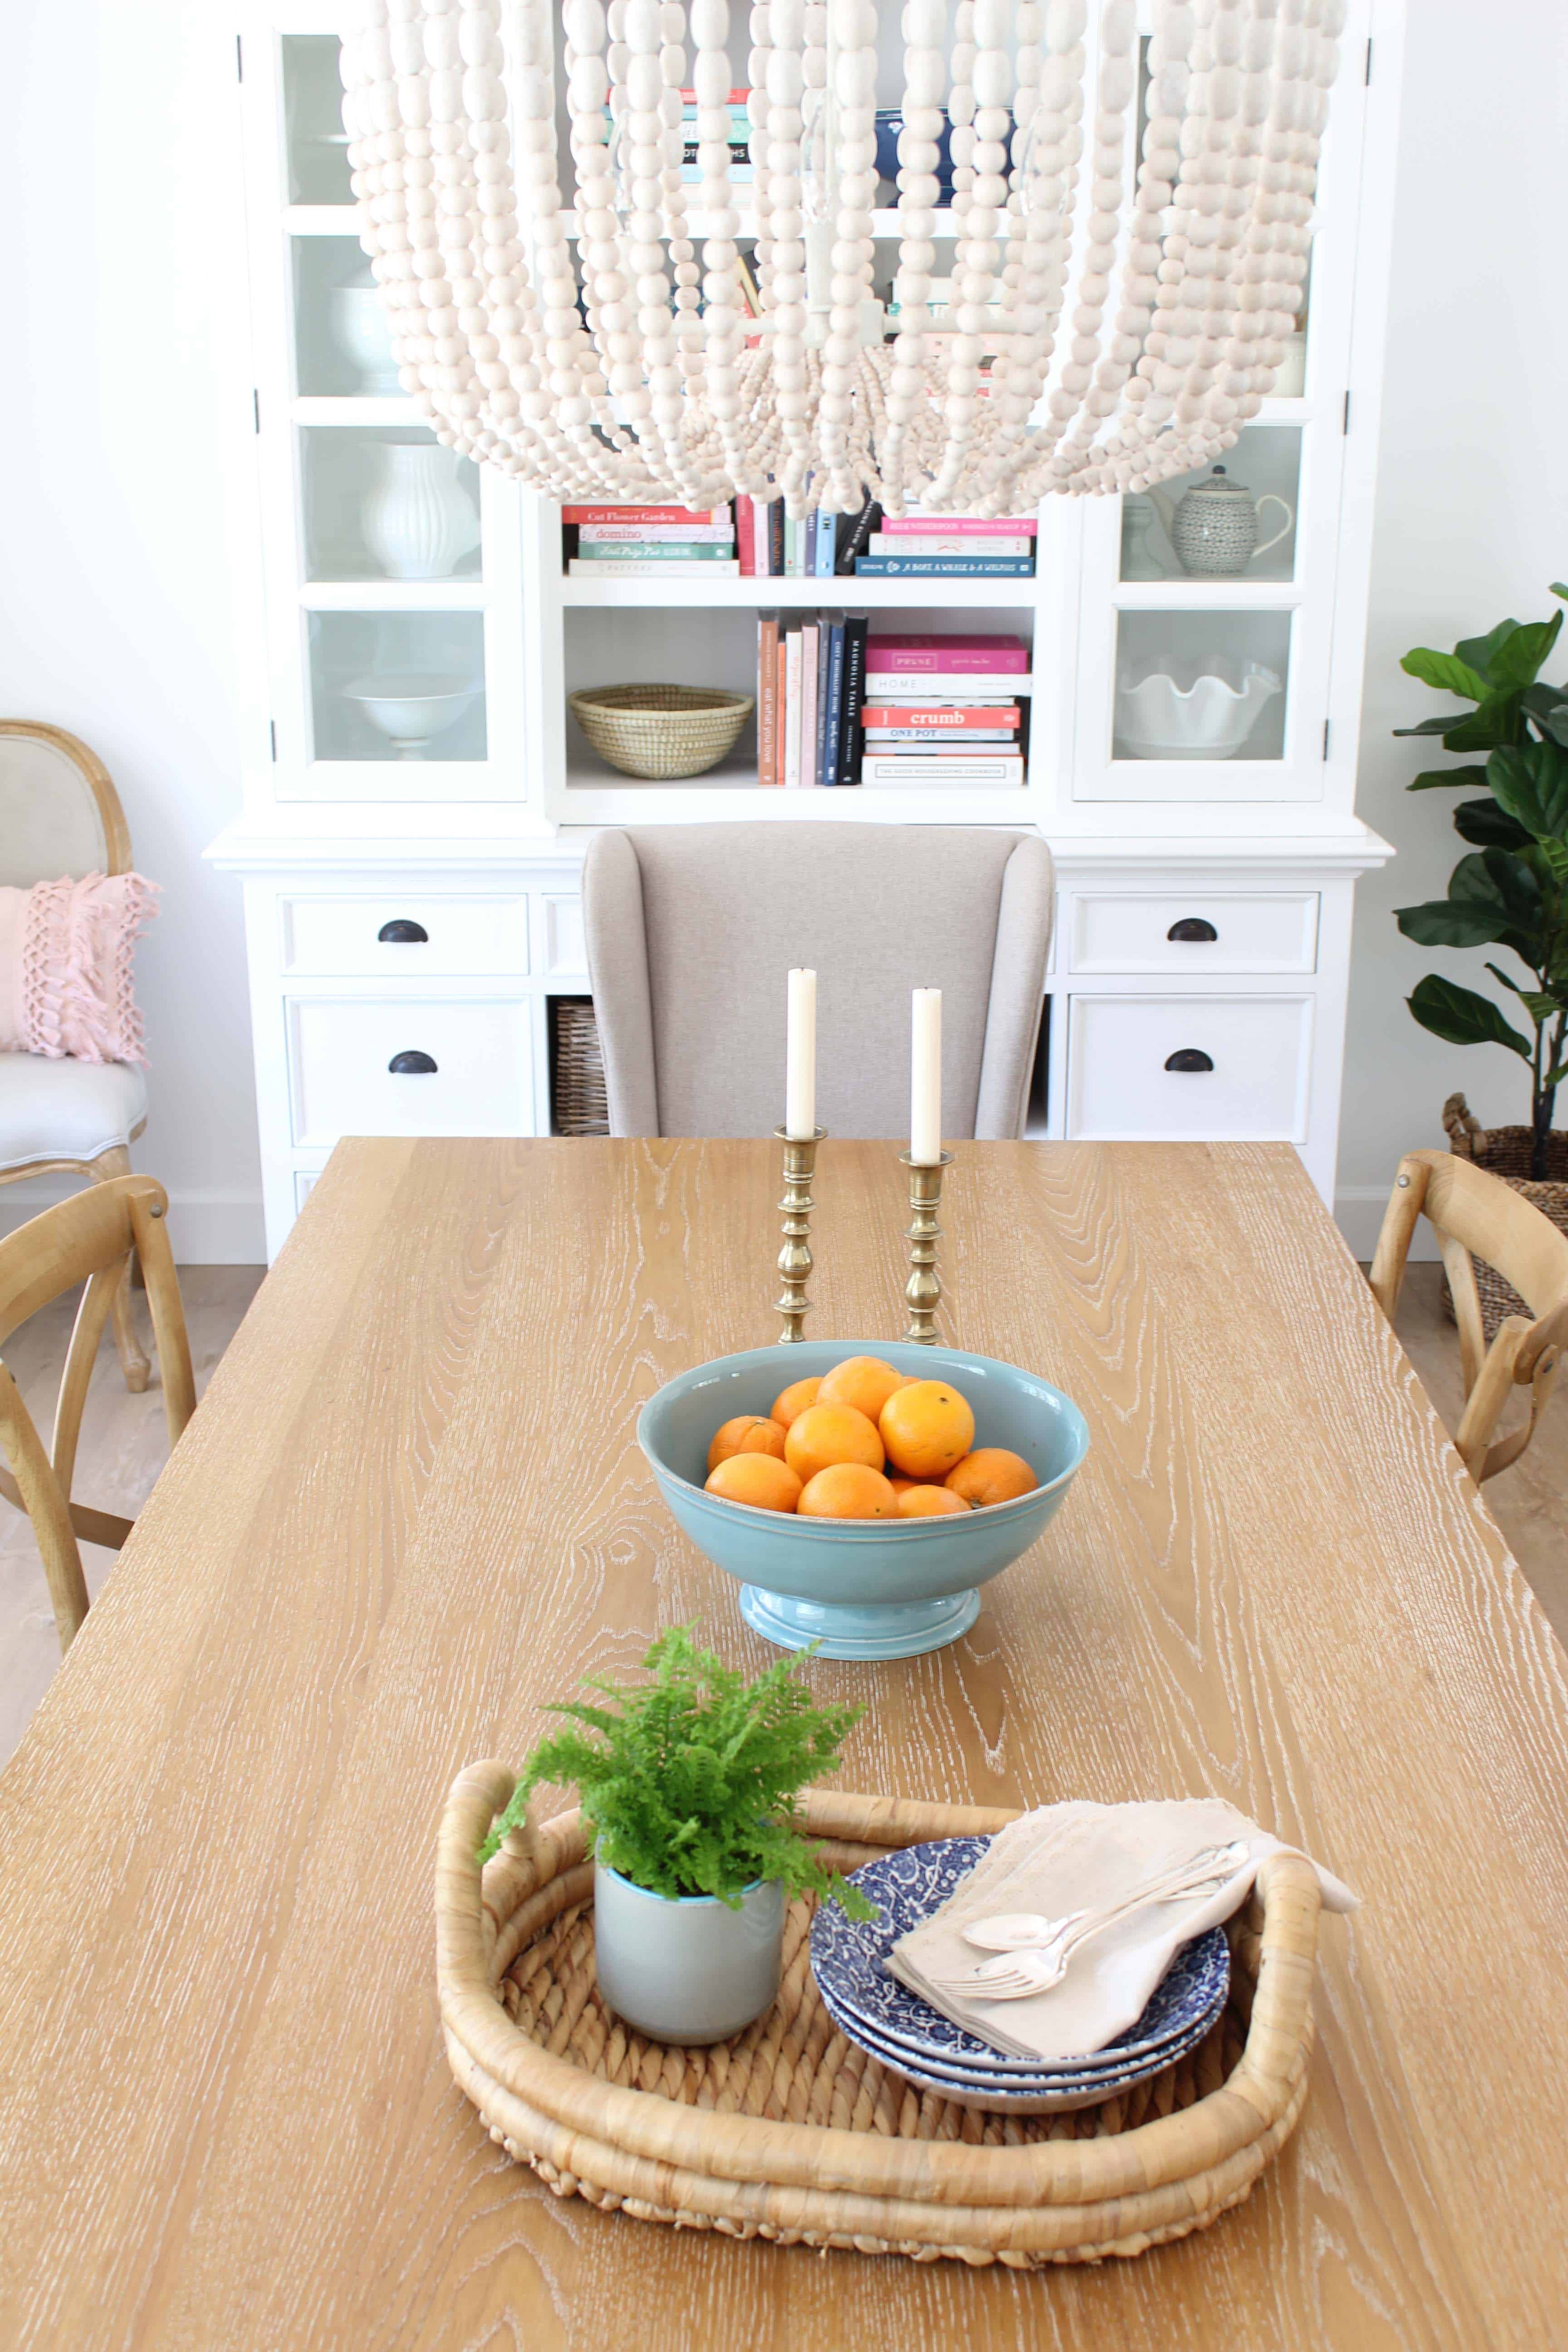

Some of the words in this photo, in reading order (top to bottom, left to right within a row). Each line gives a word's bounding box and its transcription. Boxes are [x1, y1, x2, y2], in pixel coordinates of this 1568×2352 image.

[641, 512, 676, 521] Garden
[597, 529, 642, 538] domino
[850, 640, 859, 686] MAGNOLIA
[833, 659, 841, 694] MINIMALIST
[878, 680, 918, 688] HOME
[848, 690, 857, 717] TABLE
[765, 704, 773, 725] what
[910, 711, 965, 724] crumb
[762, 726, 770, 742] you
